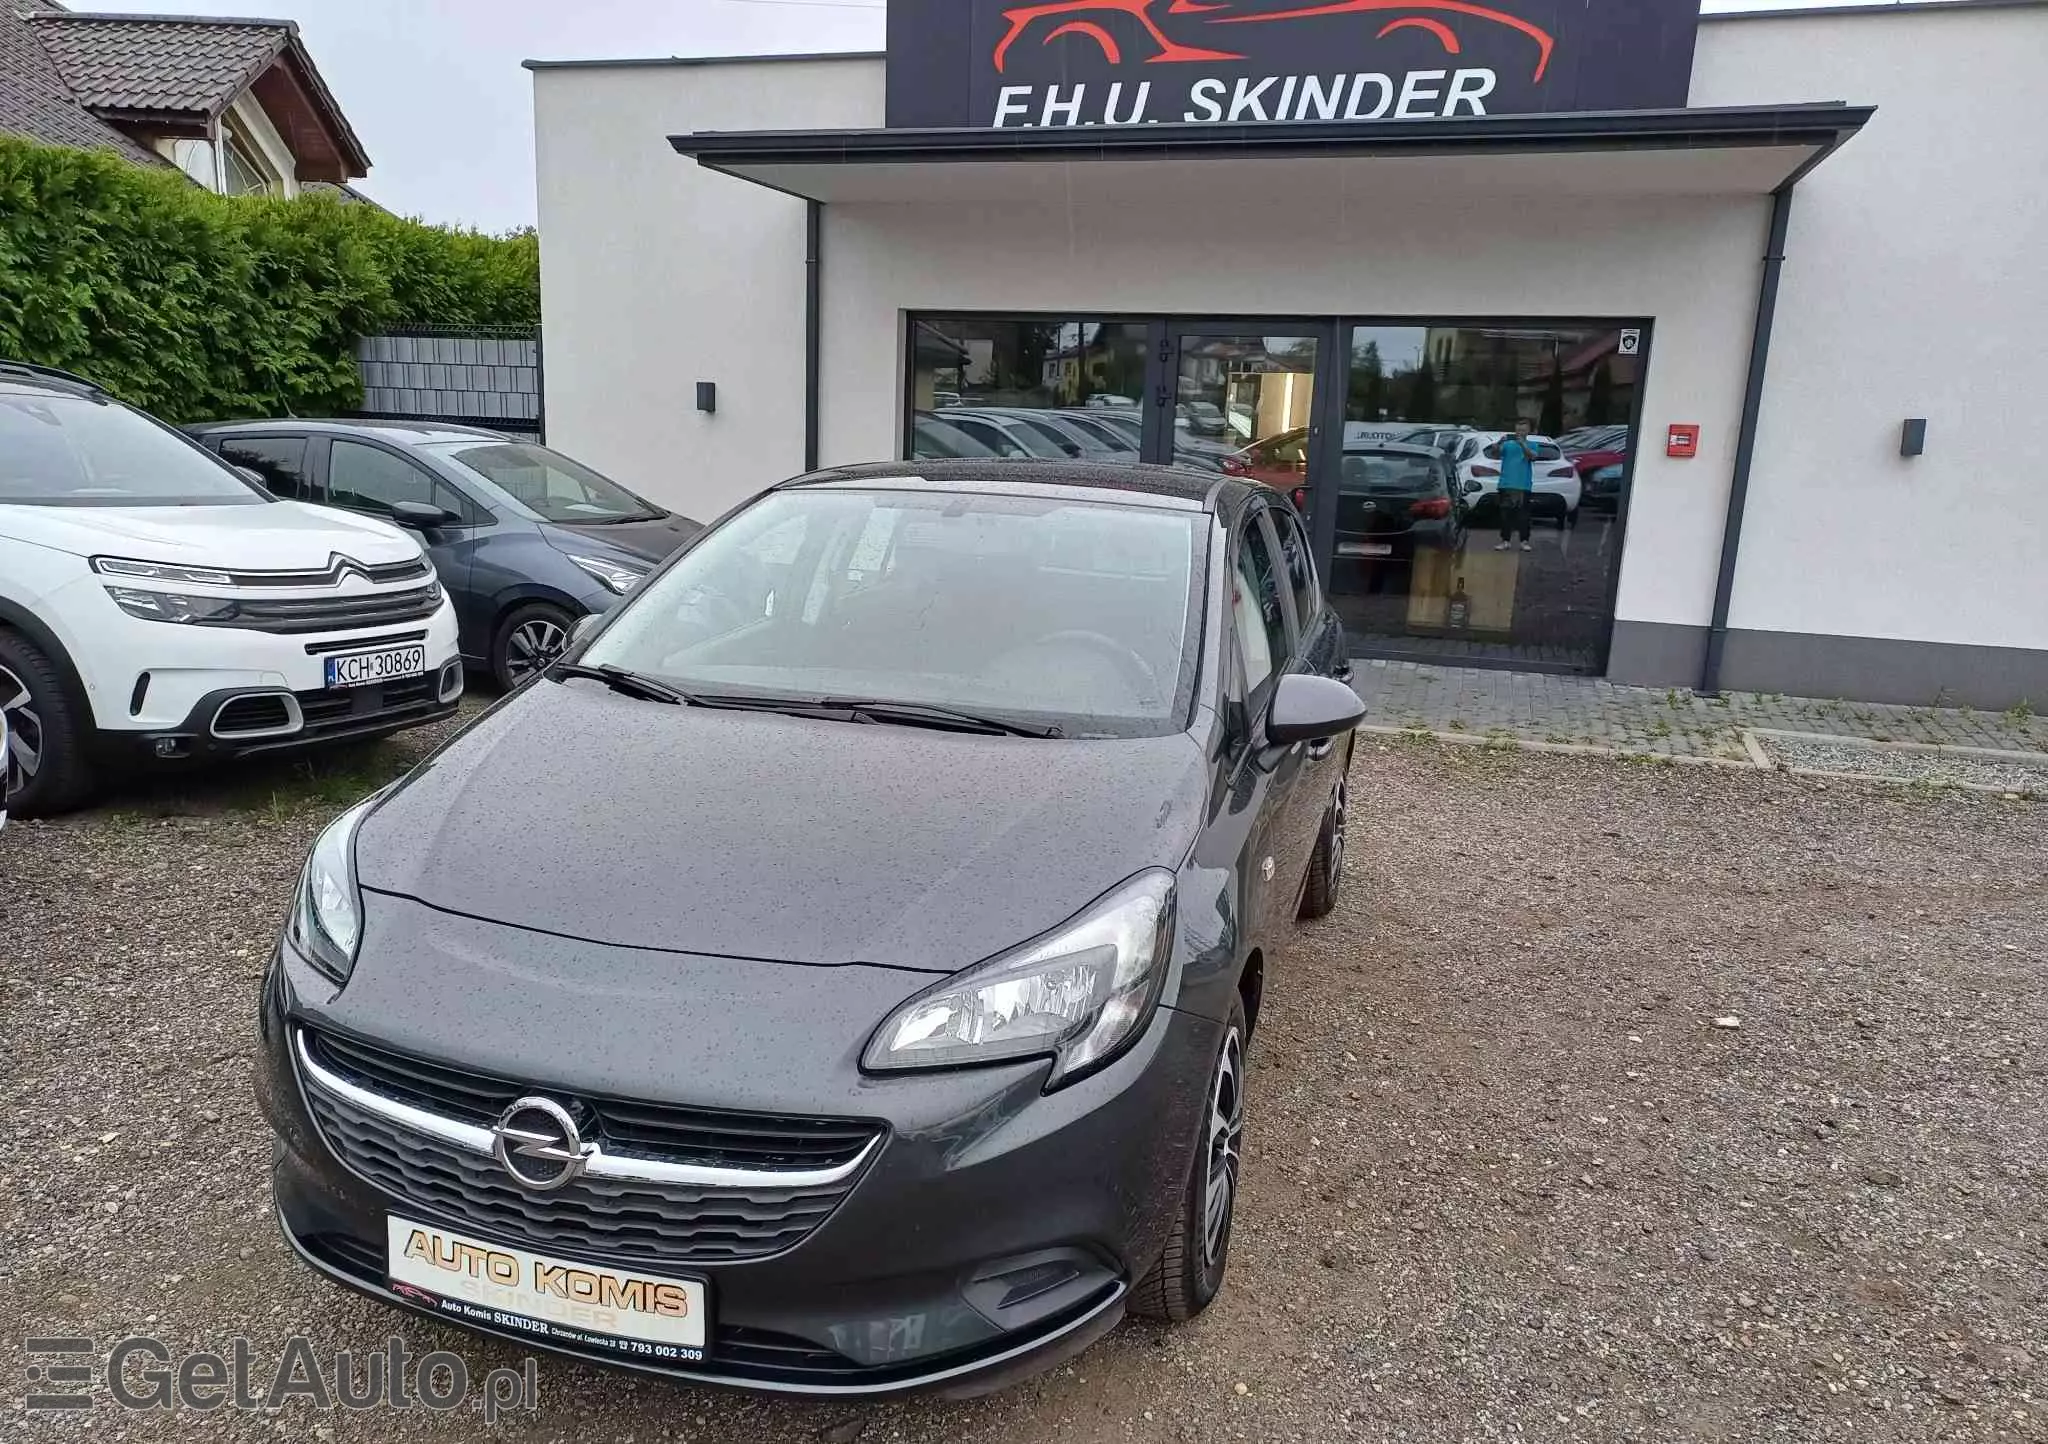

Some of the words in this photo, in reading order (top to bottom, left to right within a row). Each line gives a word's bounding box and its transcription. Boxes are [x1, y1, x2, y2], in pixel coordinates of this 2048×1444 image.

[1183, 68, 1497, 123] SKINDER
[336, 656, 370, 683] KCH
[375, 649, 421, 676] 30869
[403, 1229, 520, 1288] AUTO
[534, 1261, 688, 1318] KOMIS
[441, 1299, 462, 1313] Auto
[464, 1305, 492, 1321] Komis
[494, 1311, 549, 1335] SKINDER
[630, 1341, 652, 1354] 793
[655, 1345, 678, 1358] 002
[680, 1348, 703, 1361] 309
